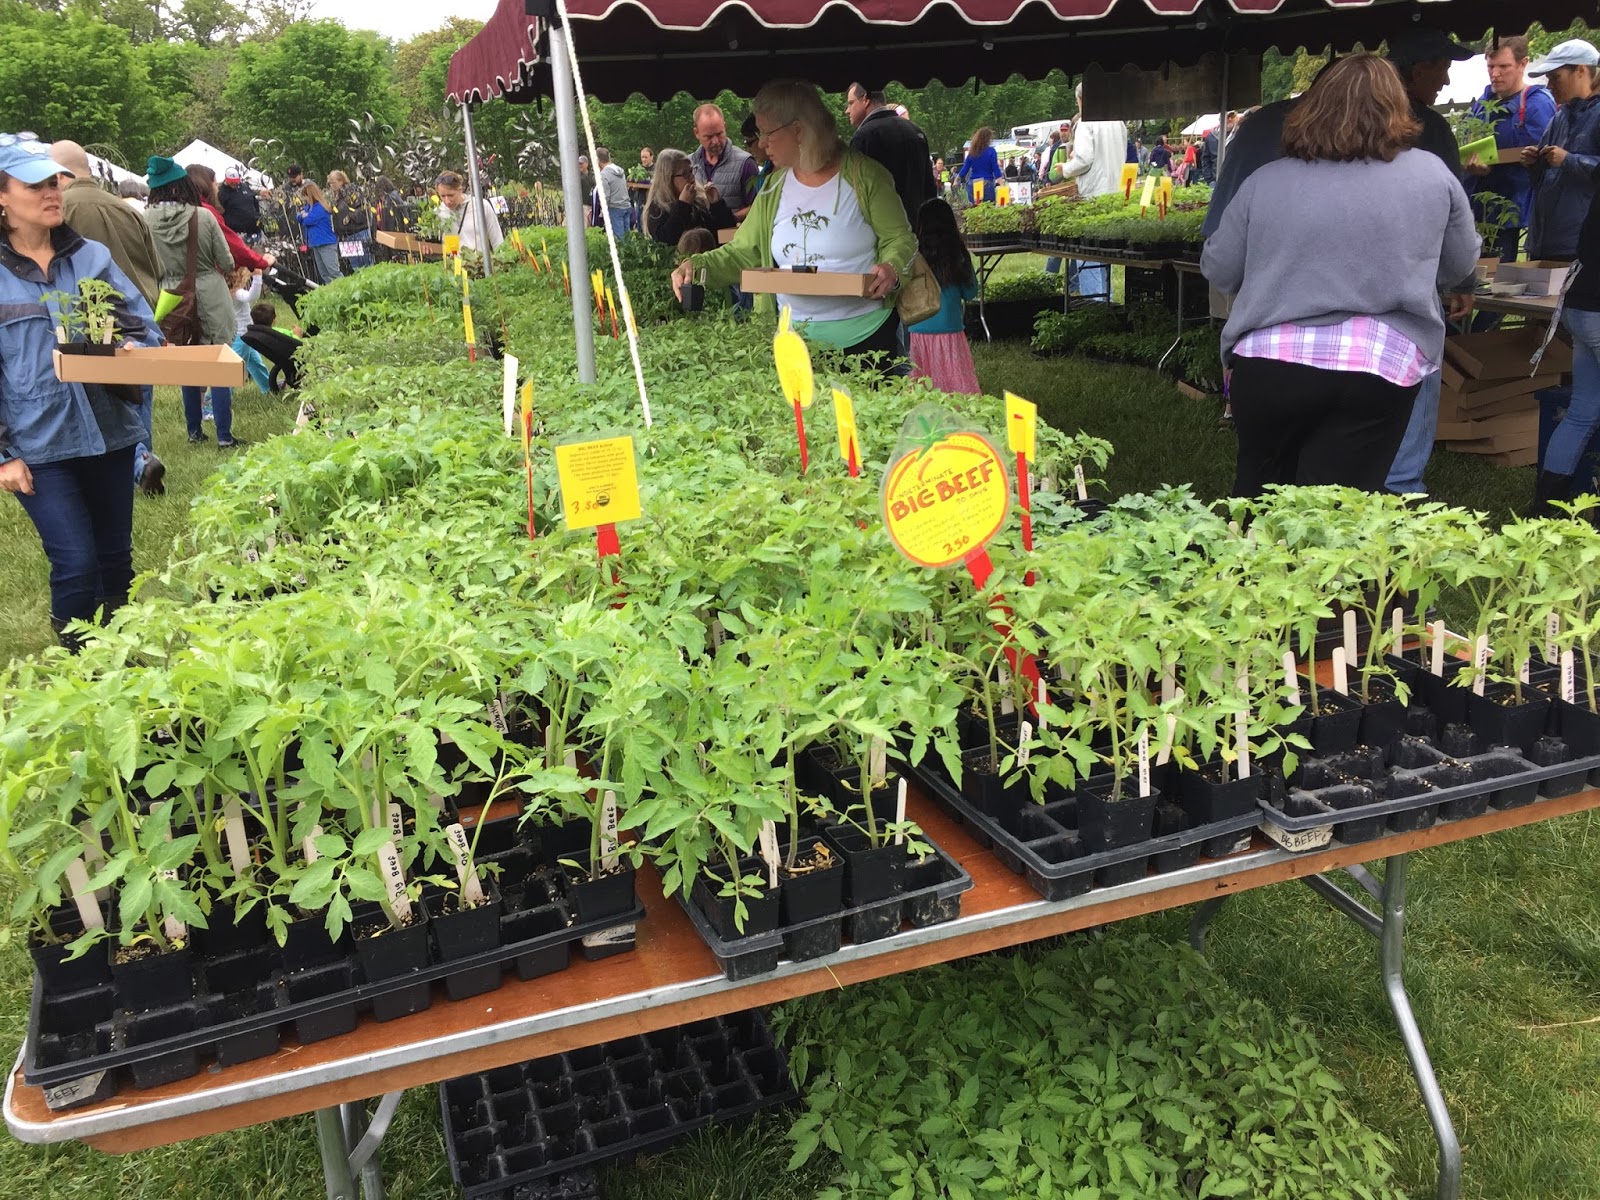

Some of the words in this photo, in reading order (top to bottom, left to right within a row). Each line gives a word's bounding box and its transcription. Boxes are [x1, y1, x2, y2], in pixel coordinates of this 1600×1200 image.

[890, 488, 936, 522] BIG
[935, 458, 994, 502] BEEF
[896, 468, 954, 499] INDETERMINATE
[968, 487, 988, 499] DAYS
[943, 535, 970, 556] 3.50
[391, 812, 402, 836] Beef
[606, 806, 616, 831] Beef
[453, 828, 466, 848] Beef
[1294, 829, 1321, 848] BEEF
[387, 855, 400, 877] Beef
